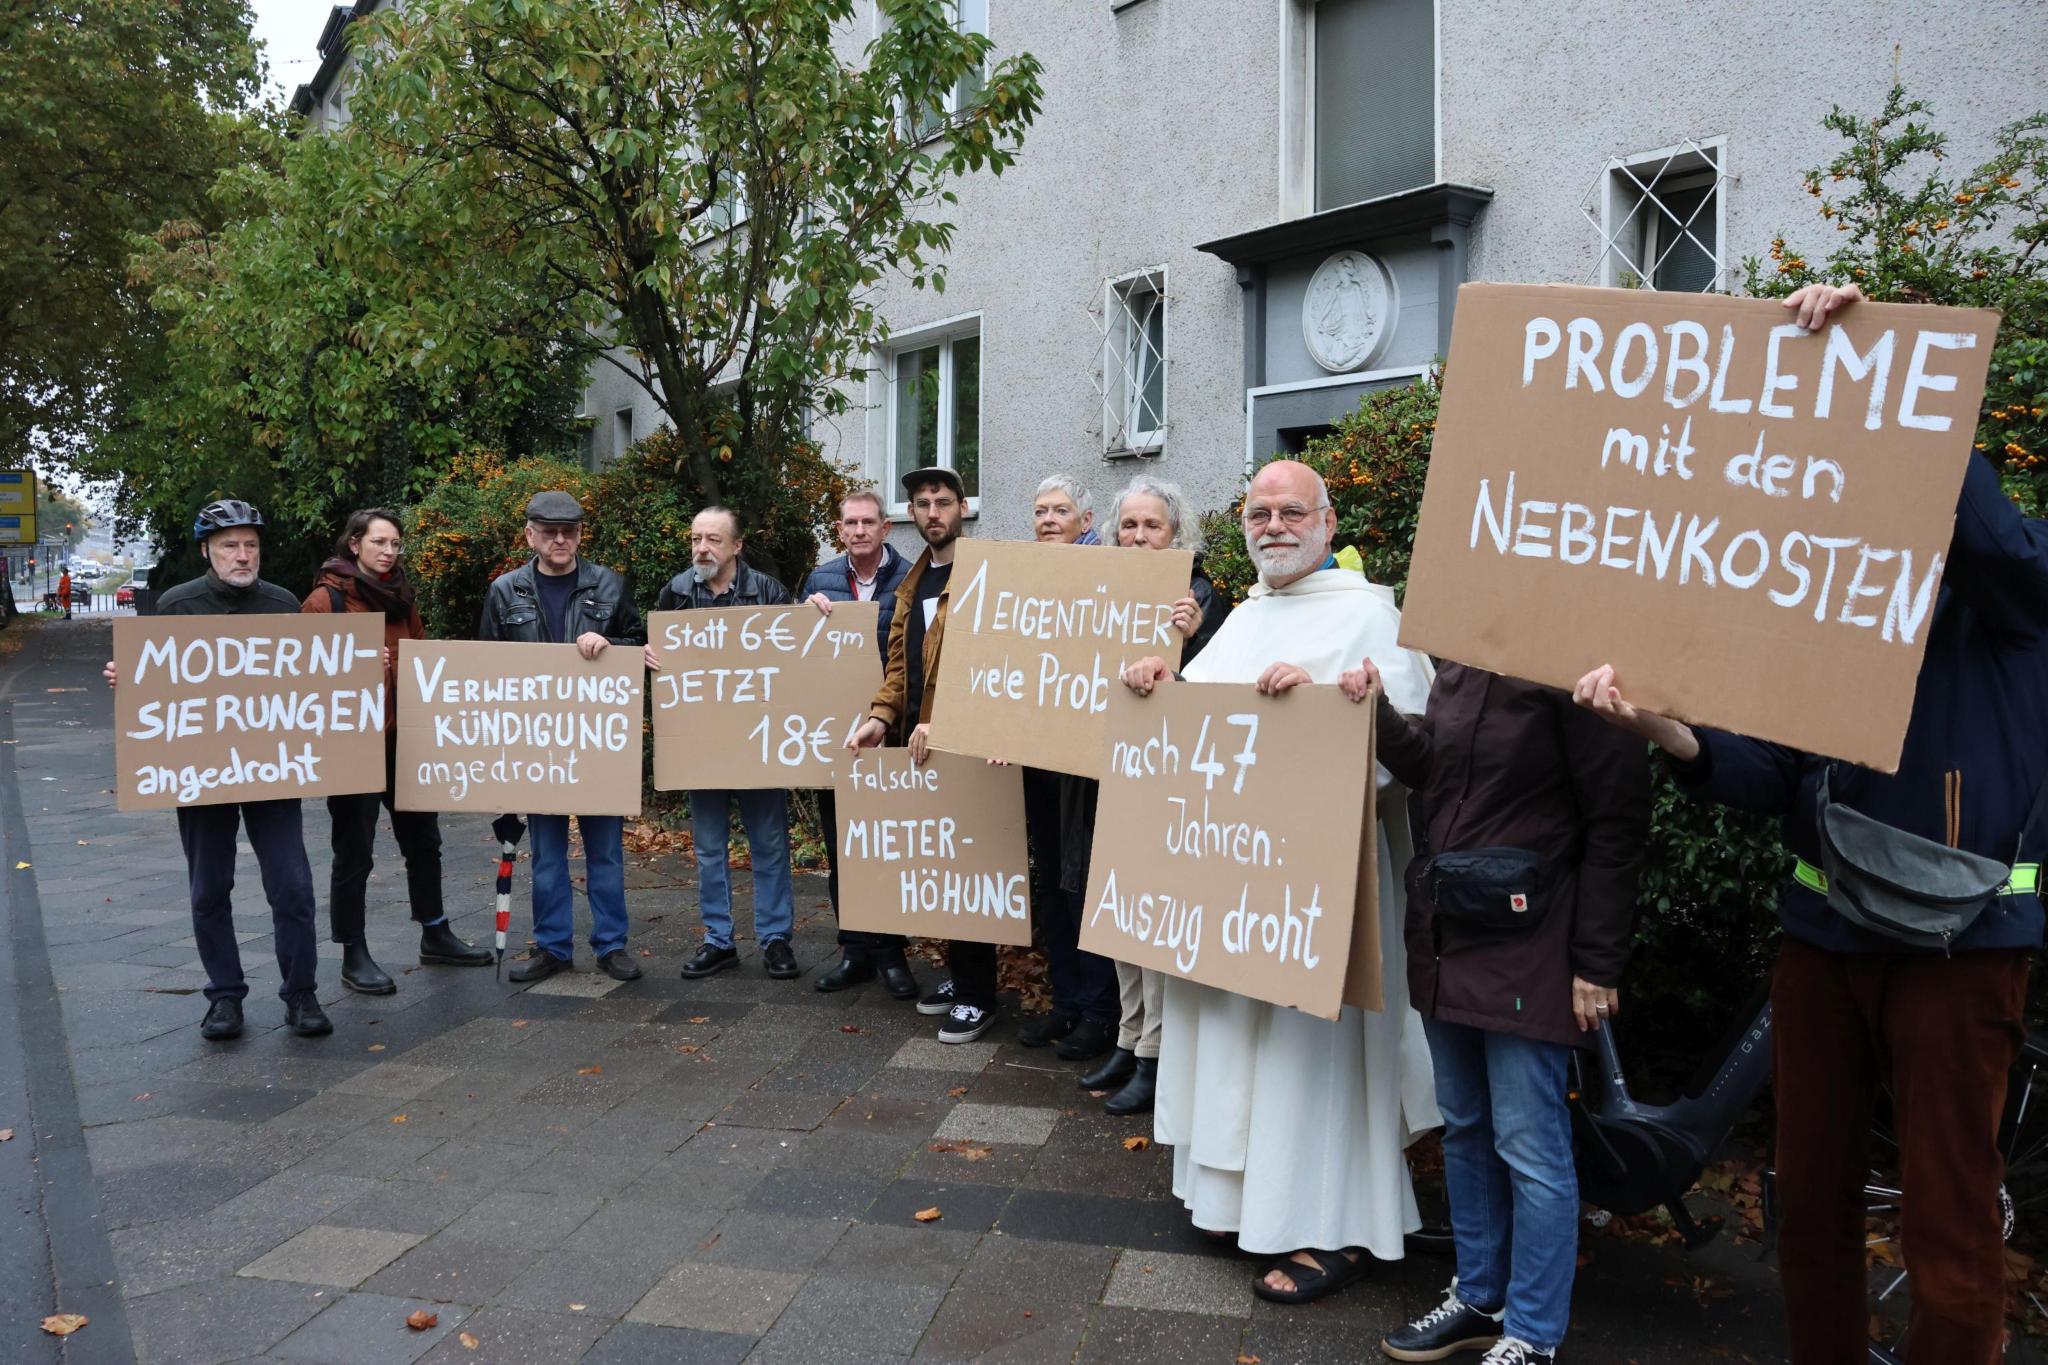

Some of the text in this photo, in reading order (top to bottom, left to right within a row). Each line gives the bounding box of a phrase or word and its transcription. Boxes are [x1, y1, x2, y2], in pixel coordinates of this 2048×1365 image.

[1523, 317, 1977, 431] PROBLEME
[1602, 416, 1844, 503] mit den
[1470, 471, 1946, 644] NEBENKOSTEN
[953, 559, 1173, 647] 1 EIGENTÜMER
[134, 633, 377, 685] MODERNI-
[664, 617, 728, 650] Statt
[413, 656, 641, 706] VERWERTUNGS-
[656, 667, 780, 709] JETZT
[970, 654, 1025, 700] viele
[126, 682, 385, 742] SIERUNGEN
[434, 708, 629, 752] KÜNDIGUNG
[135, 740, 321, 803] angedroht
[417, 748, 580, 801] angedroht
[848, 756, 938, 792] falsche
[1112, 713, 1258, 795] nach 47
[844, 816, 974, 862] MIETER-
[1166, 795, 1286, 866] Jahren:
[900, 867, 1026, 920] HÖHUNG
[1091, 868, 1322, 973] Auszug droht
